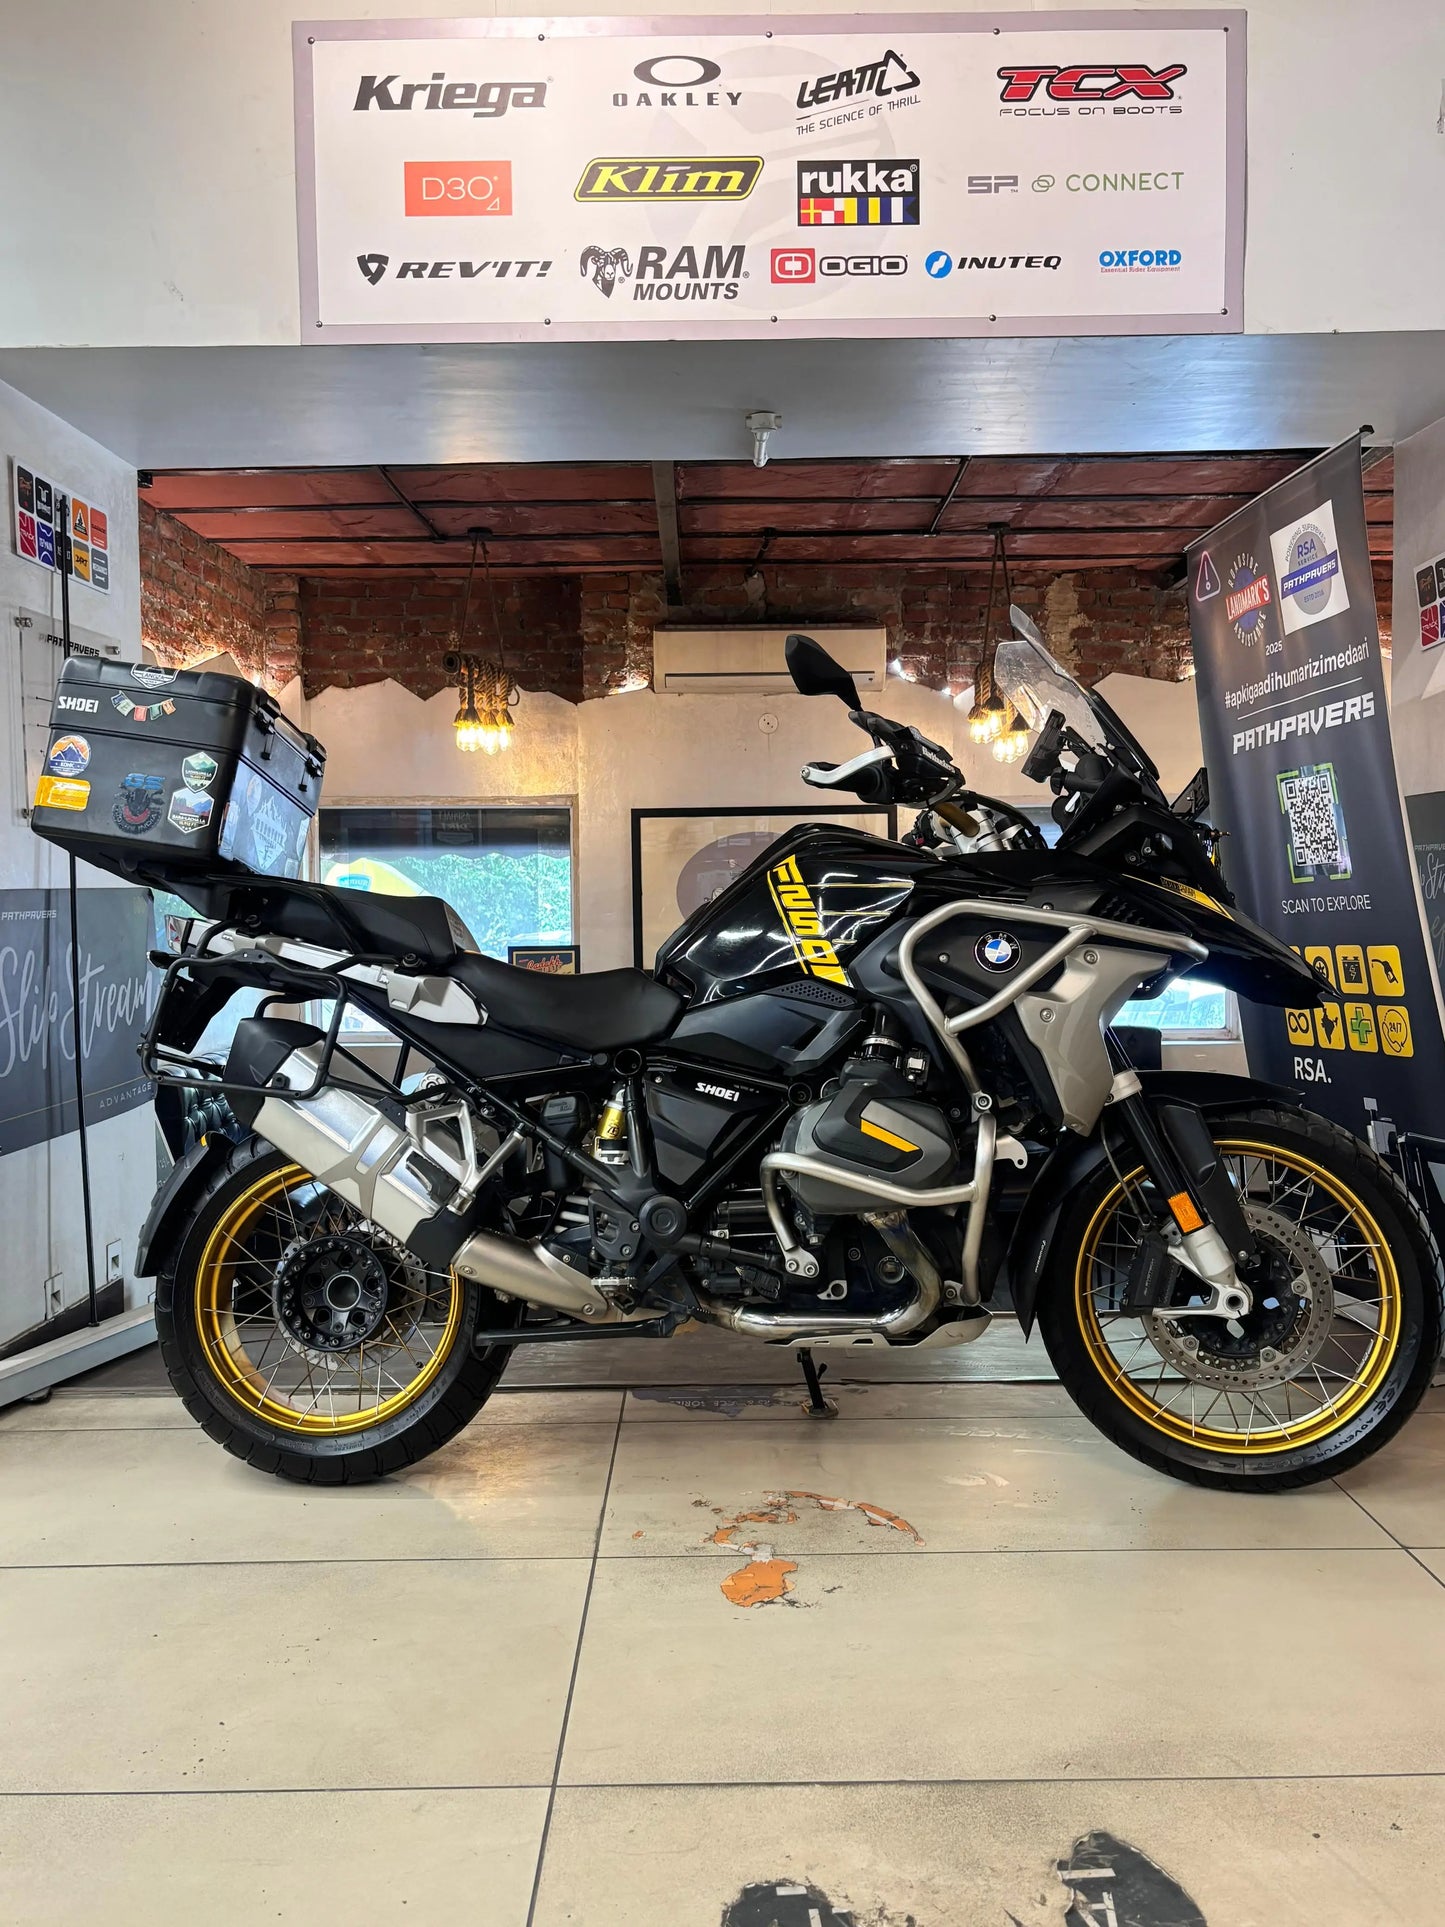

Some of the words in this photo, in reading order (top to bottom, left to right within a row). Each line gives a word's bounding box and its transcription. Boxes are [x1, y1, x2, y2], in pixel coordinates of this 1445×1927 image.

[997, 64, 1187, 102] TCX
[353, 72, 548, 118] Kriega
[612, 92, 742, 107] OAKLEY
[796, 122, 815, 135] THE
[819, 109, 864, 130] SCIENCE
[868, 104, 883, 116] OF
[887, 95, 921, 111] THRILL
[999, 106, 1070, 117] FOCUS
[1113, 105, 1183, 115] BOOTS
[801, 163, 913, 194] rukka
[967, 175, 1019, 194] SP
[1065, 172, 1184, 192] CONNECT
[636, 245, 747, 279] RAM
[819, 255, 908, 276] OGIO
[957, 255, 1062, 271] INUTEQ
[1099, 249, 1182, 267] OXFORD
[396, 261, 553, 279] REV'IT!
[633, 283, 739, 301] MOUNTS
[1297, 538, 1316, 559] RSA
[1297, 553, 1318, 566] SERVICE
[1228, 552, 1259, 588] ROADSIDE
[1283, 558, 1336, 592] PATHPAVERS
[1226, 578, 1270, 620] LANDMARK'S
[1233, 610, 1267, 647] ASSISTANCE
[46, 634, 100, 656] PATPAVERS
[1265, 640, 1283, 656] 2025
[1224, 637, 1370, 709] #apkigaadihumarizimedaari
[57, 696, 99, 713] SHOEI
[1232, 692, 1375, 755] PATHPAVERS
[1, 909, 57, 921] PATHPAVERS
[1281, 898, 1309, 915] SCAN
[1310, 897, 1325, 913] TO
[1326, 894, 1372, 912] EXPLORE
[1294, 1057, 1332, 1084] RSA.
[99, 1082, 152, 1109] ADVANTAGE
[695, 1081, 740, 1102] SHOEI
